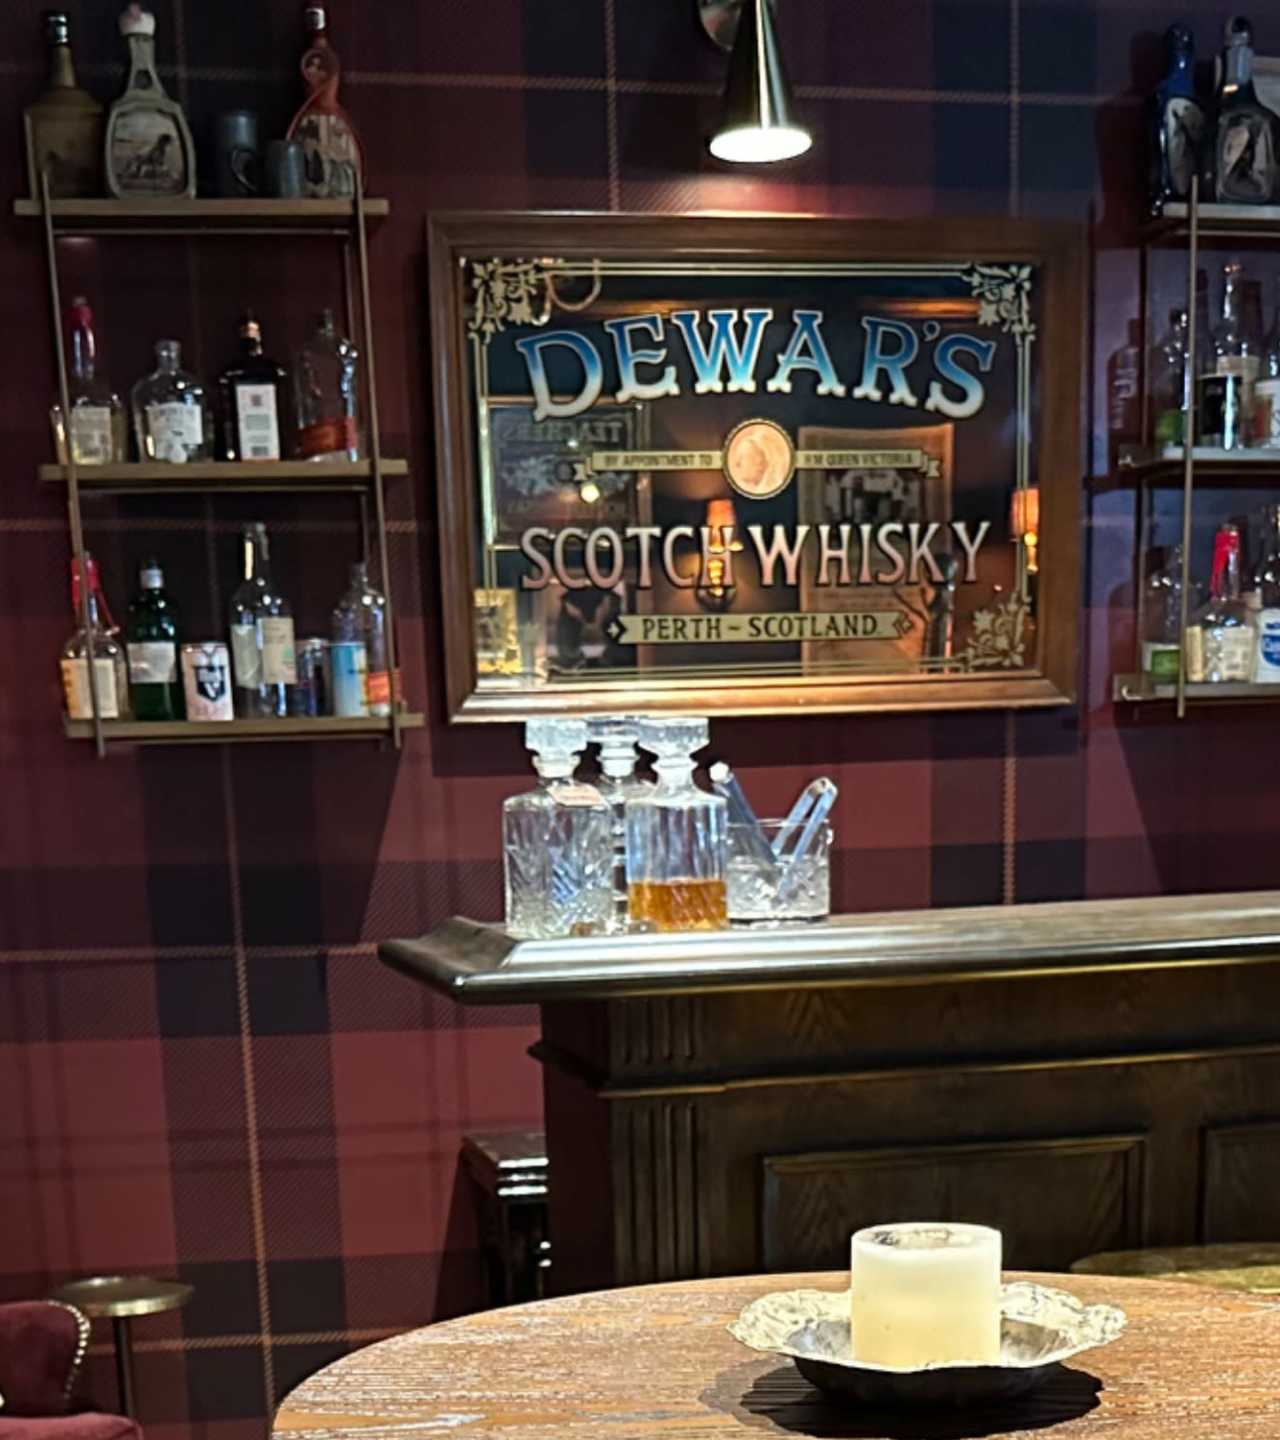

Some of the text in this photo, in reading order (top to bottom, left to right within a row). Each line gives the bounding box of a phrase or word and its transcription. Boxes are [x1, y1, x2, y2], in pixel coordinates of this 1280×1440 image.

[515, 308, 997, 421] DEWAR'S
[623, 453, 695, 466] APPOINTMENT
[699, 453, 713, 465] TO
[826, 453, 860, 465] QUEEN
[861, 453, 913, 465] VICTORIA
[521, 522, 990, 589] SCOTCH WHISKY
[642, 616, 719, 640] PERTH
[749, 614, 877, 637] SCOTLAND
